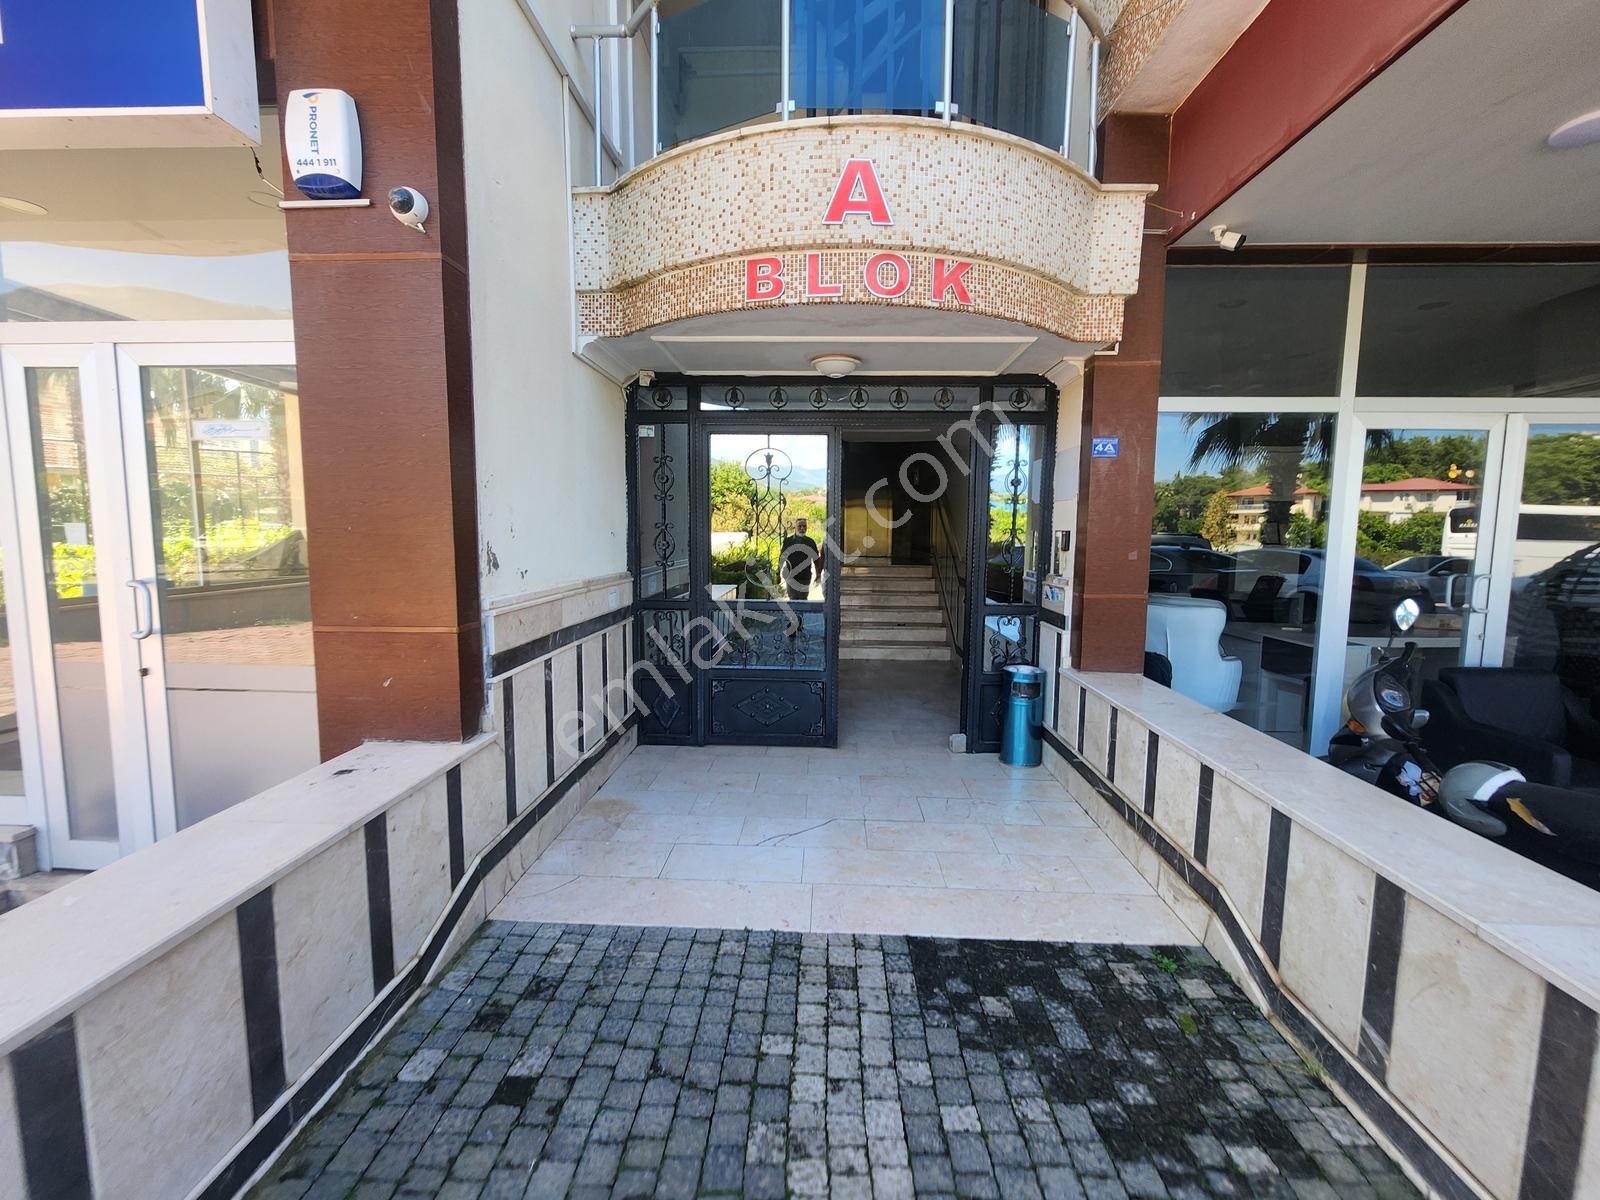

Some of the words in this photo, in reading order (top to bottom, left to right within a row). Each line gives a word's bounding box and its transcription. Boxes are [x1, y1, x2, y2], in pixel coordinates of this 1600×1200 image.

[309, 106, 319, 155] PRONET
[296, 159, 315, 167] 444
[323, 159, 337, 167] 911
[822, 158, 895, 225] A
[745, 252, 975, 306] BLOK
